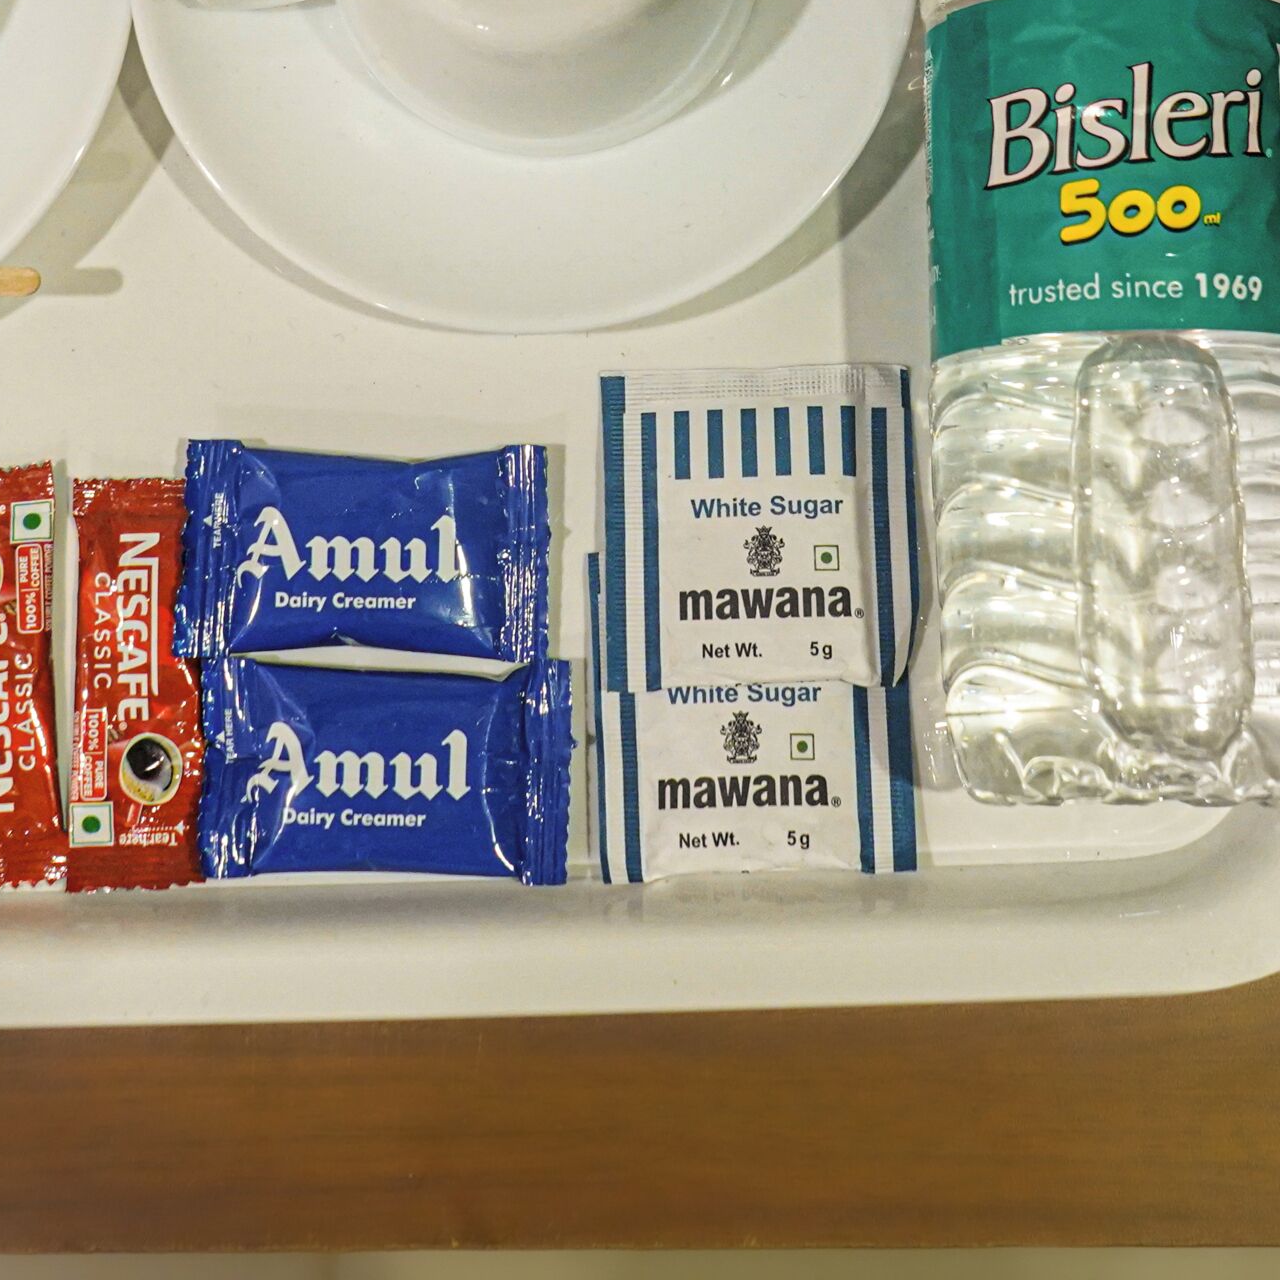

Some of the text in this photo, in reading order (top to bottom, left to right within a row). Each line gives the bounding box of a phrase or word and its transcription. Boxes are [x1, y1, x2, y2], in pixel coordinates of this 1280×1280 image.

[984, 61, 1265, 191] Bisleri
[1008, 272, 1263, 306] trusted since 1969
[213, 492, 224, 549] TEAR HERE
[691, 495, 844, 519] White Sugar
[237, 506, 465, 588] Amul
[20, 555, 29, 583] PURE
[30, 547, 40, 587] COFFEE
[25, 591, 37, 630] 100%
[275, 591, 417, 613] Dairy Creamer
[93, 572, 112, 689] CLASSIC
[702, 643, 730, 659] Net
[735, 642, 763, 658] Wt.
[14, 653, 36, 771] CLASSIC
[667, 682, 821, 707] White Sugar
[88, 713, 99, 750] 100%
[224, 708, 235, 765] TEAR HERE
[95, 760, 105, 789] PURE
[241, 721, 471, 803] Amul
[283, 807, 427, 829] Dairy Creamer
[149, 832, 178, 847] Tear
[679, 832, 707, 849] Net
[712, 831, 740, 847] Wt.
